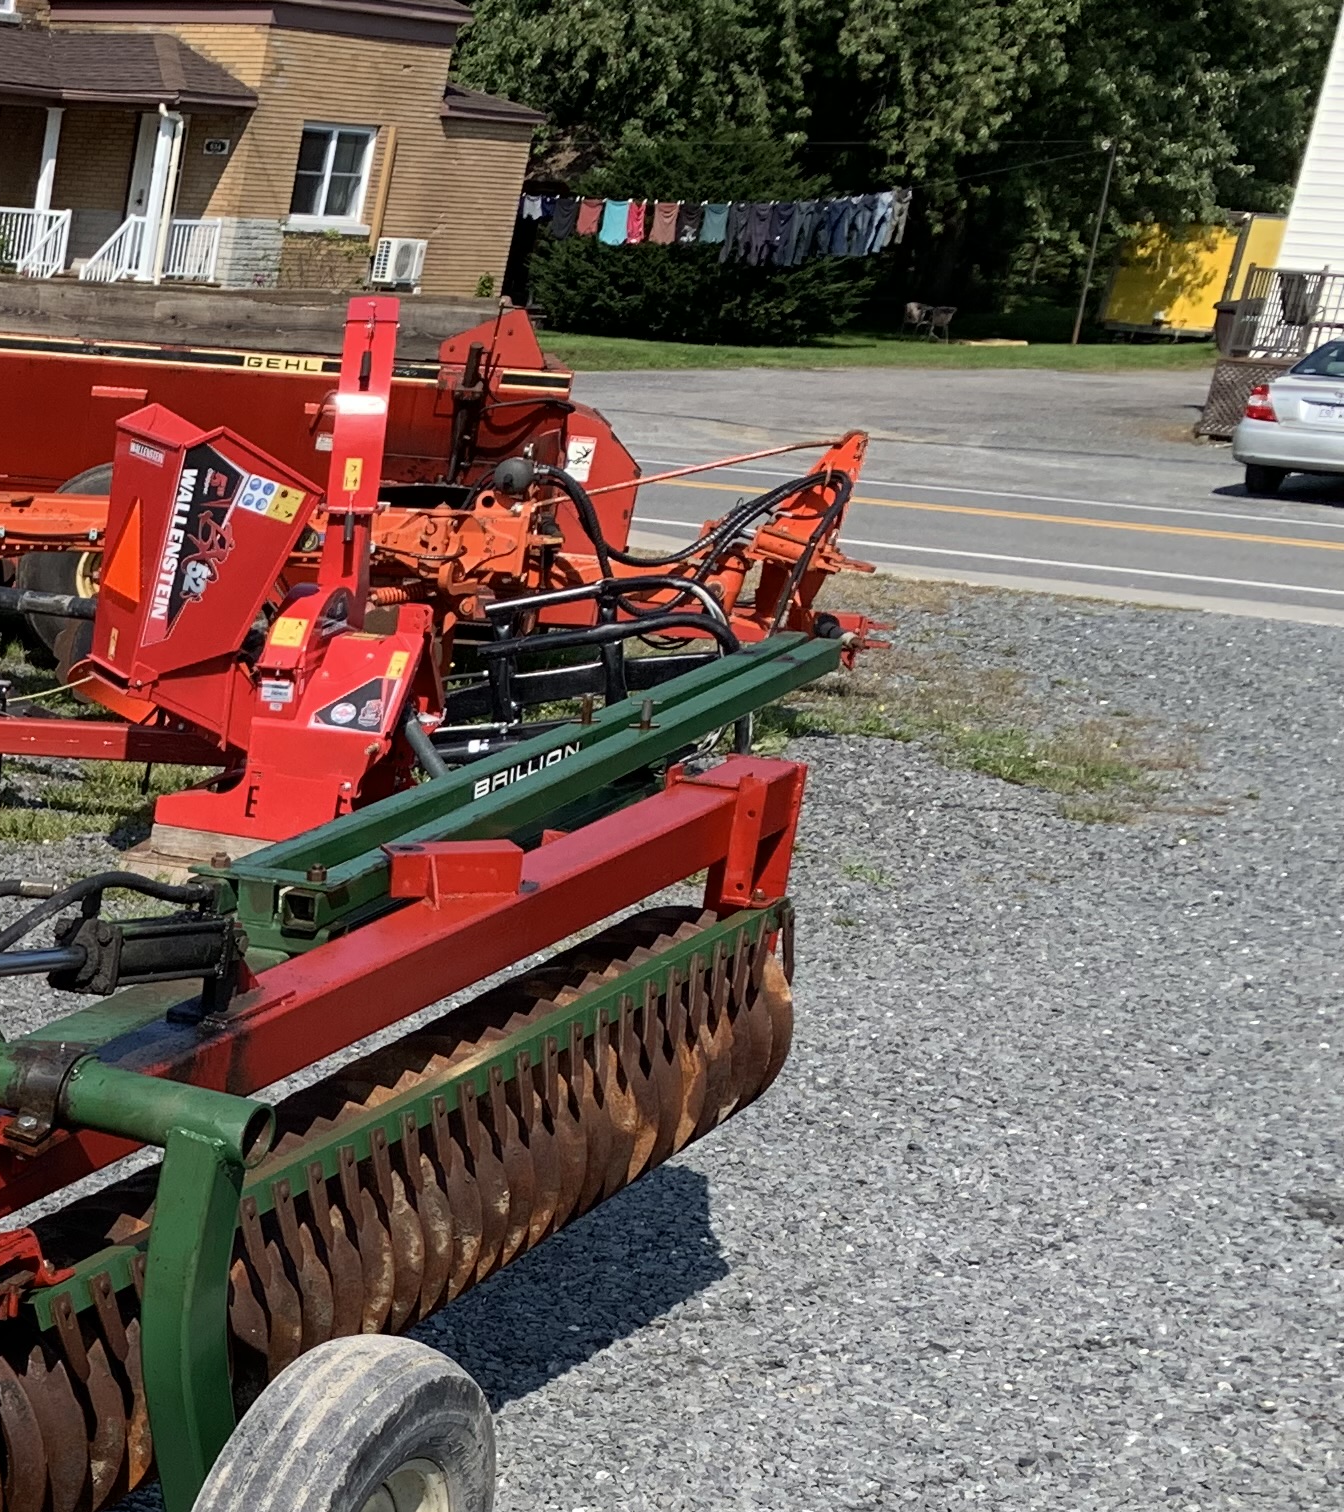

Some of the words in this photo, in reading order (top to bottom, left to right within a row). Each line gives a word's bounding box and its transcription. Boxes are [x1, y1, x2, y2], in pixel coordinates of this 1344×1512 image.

[247, 356, 318, 372] GEHL
[151, 468, 198, 620] WALLENSTEIN
[473, 741, 581, 800] BRILLION
